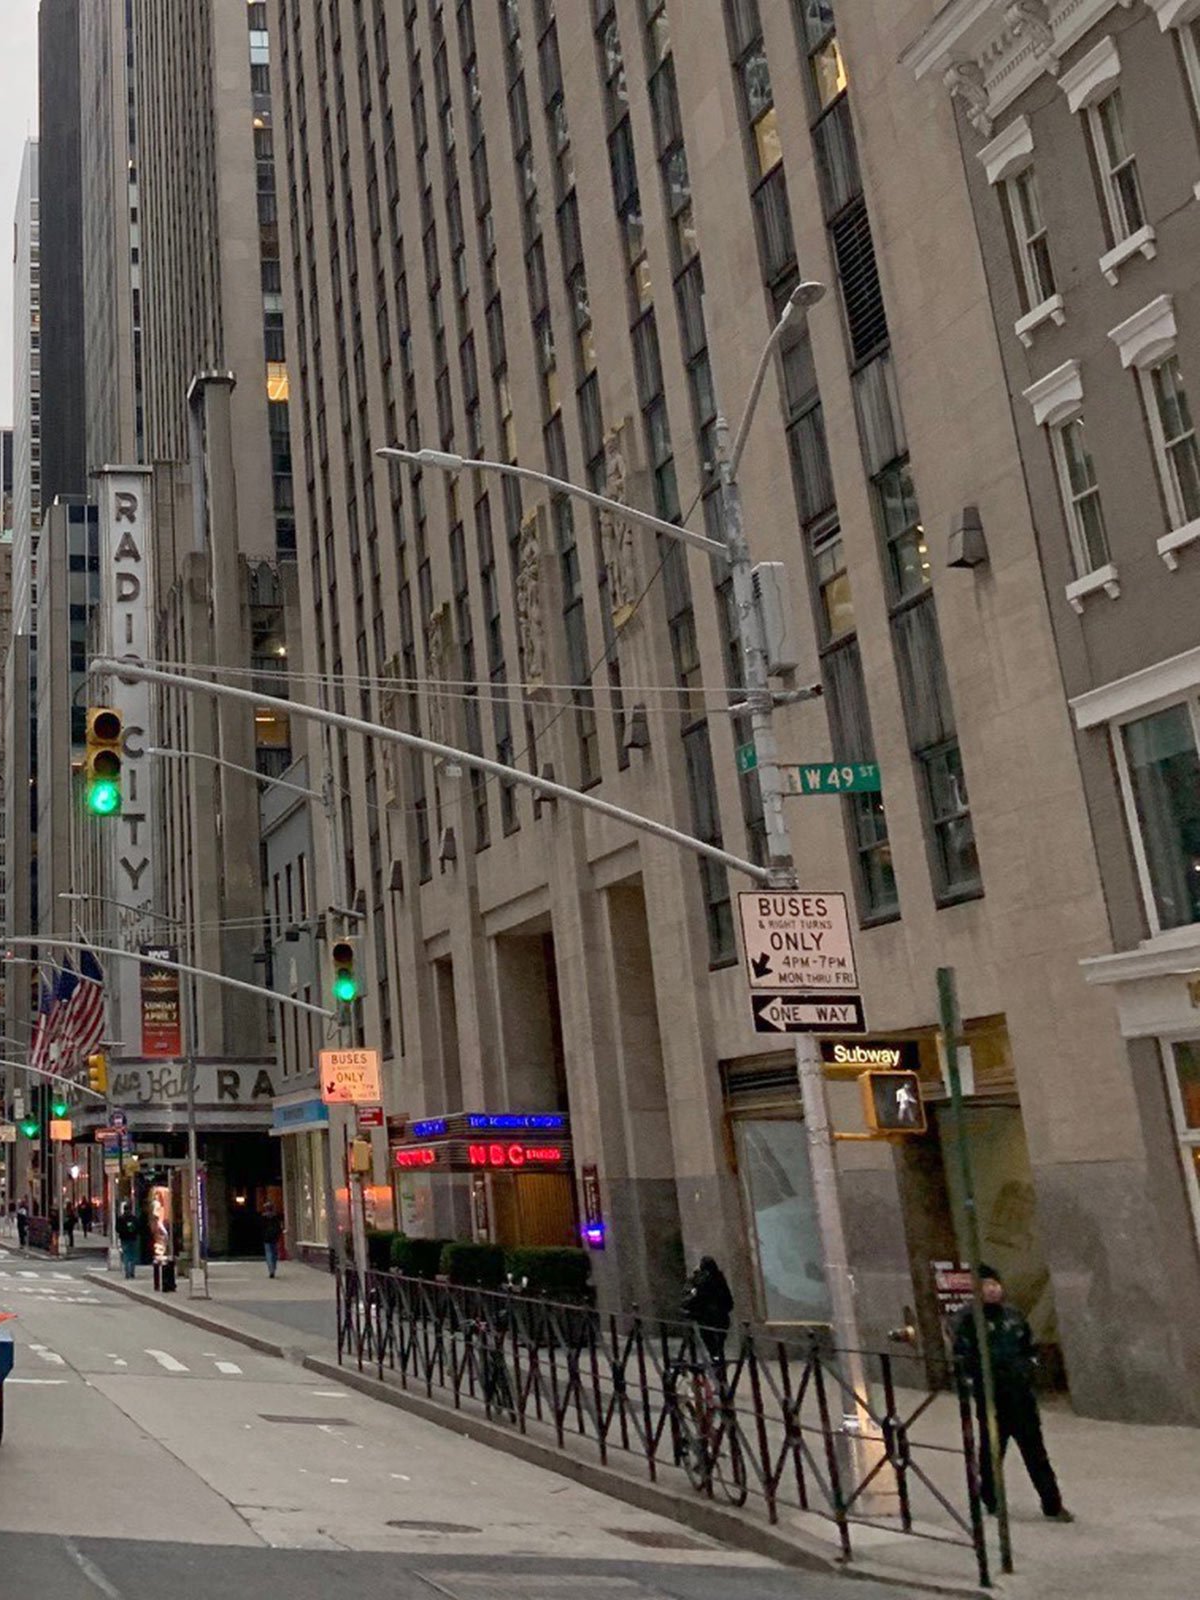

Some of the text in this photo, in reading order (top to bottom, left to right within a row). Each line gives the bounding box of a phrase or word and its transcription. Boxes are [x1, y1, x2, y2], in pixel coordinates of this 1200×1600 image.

[114, 491, 150, 891] RADIO CITY
[805, 764, 874, 790] W 49 ST
[758, 897, 828, 917] BUSES
[768, 919, 797, 930] RIGHT
[800, 919, 833, 931] TURNS
[770, 932, 824, 951] ONLY
[782, 954, 847, 969] 4PM-7PM
[778, 971, 854, 984] MON THRU FRI
[769, 1006, 849, 1022] ONE WAY
[331, 1054, 368, 1064] BUSES
[833, 1044, 900, 1066] Subway
[336, 1072, 365, 1083] ONLY
[468, 1144, 525, 1166] NBC
